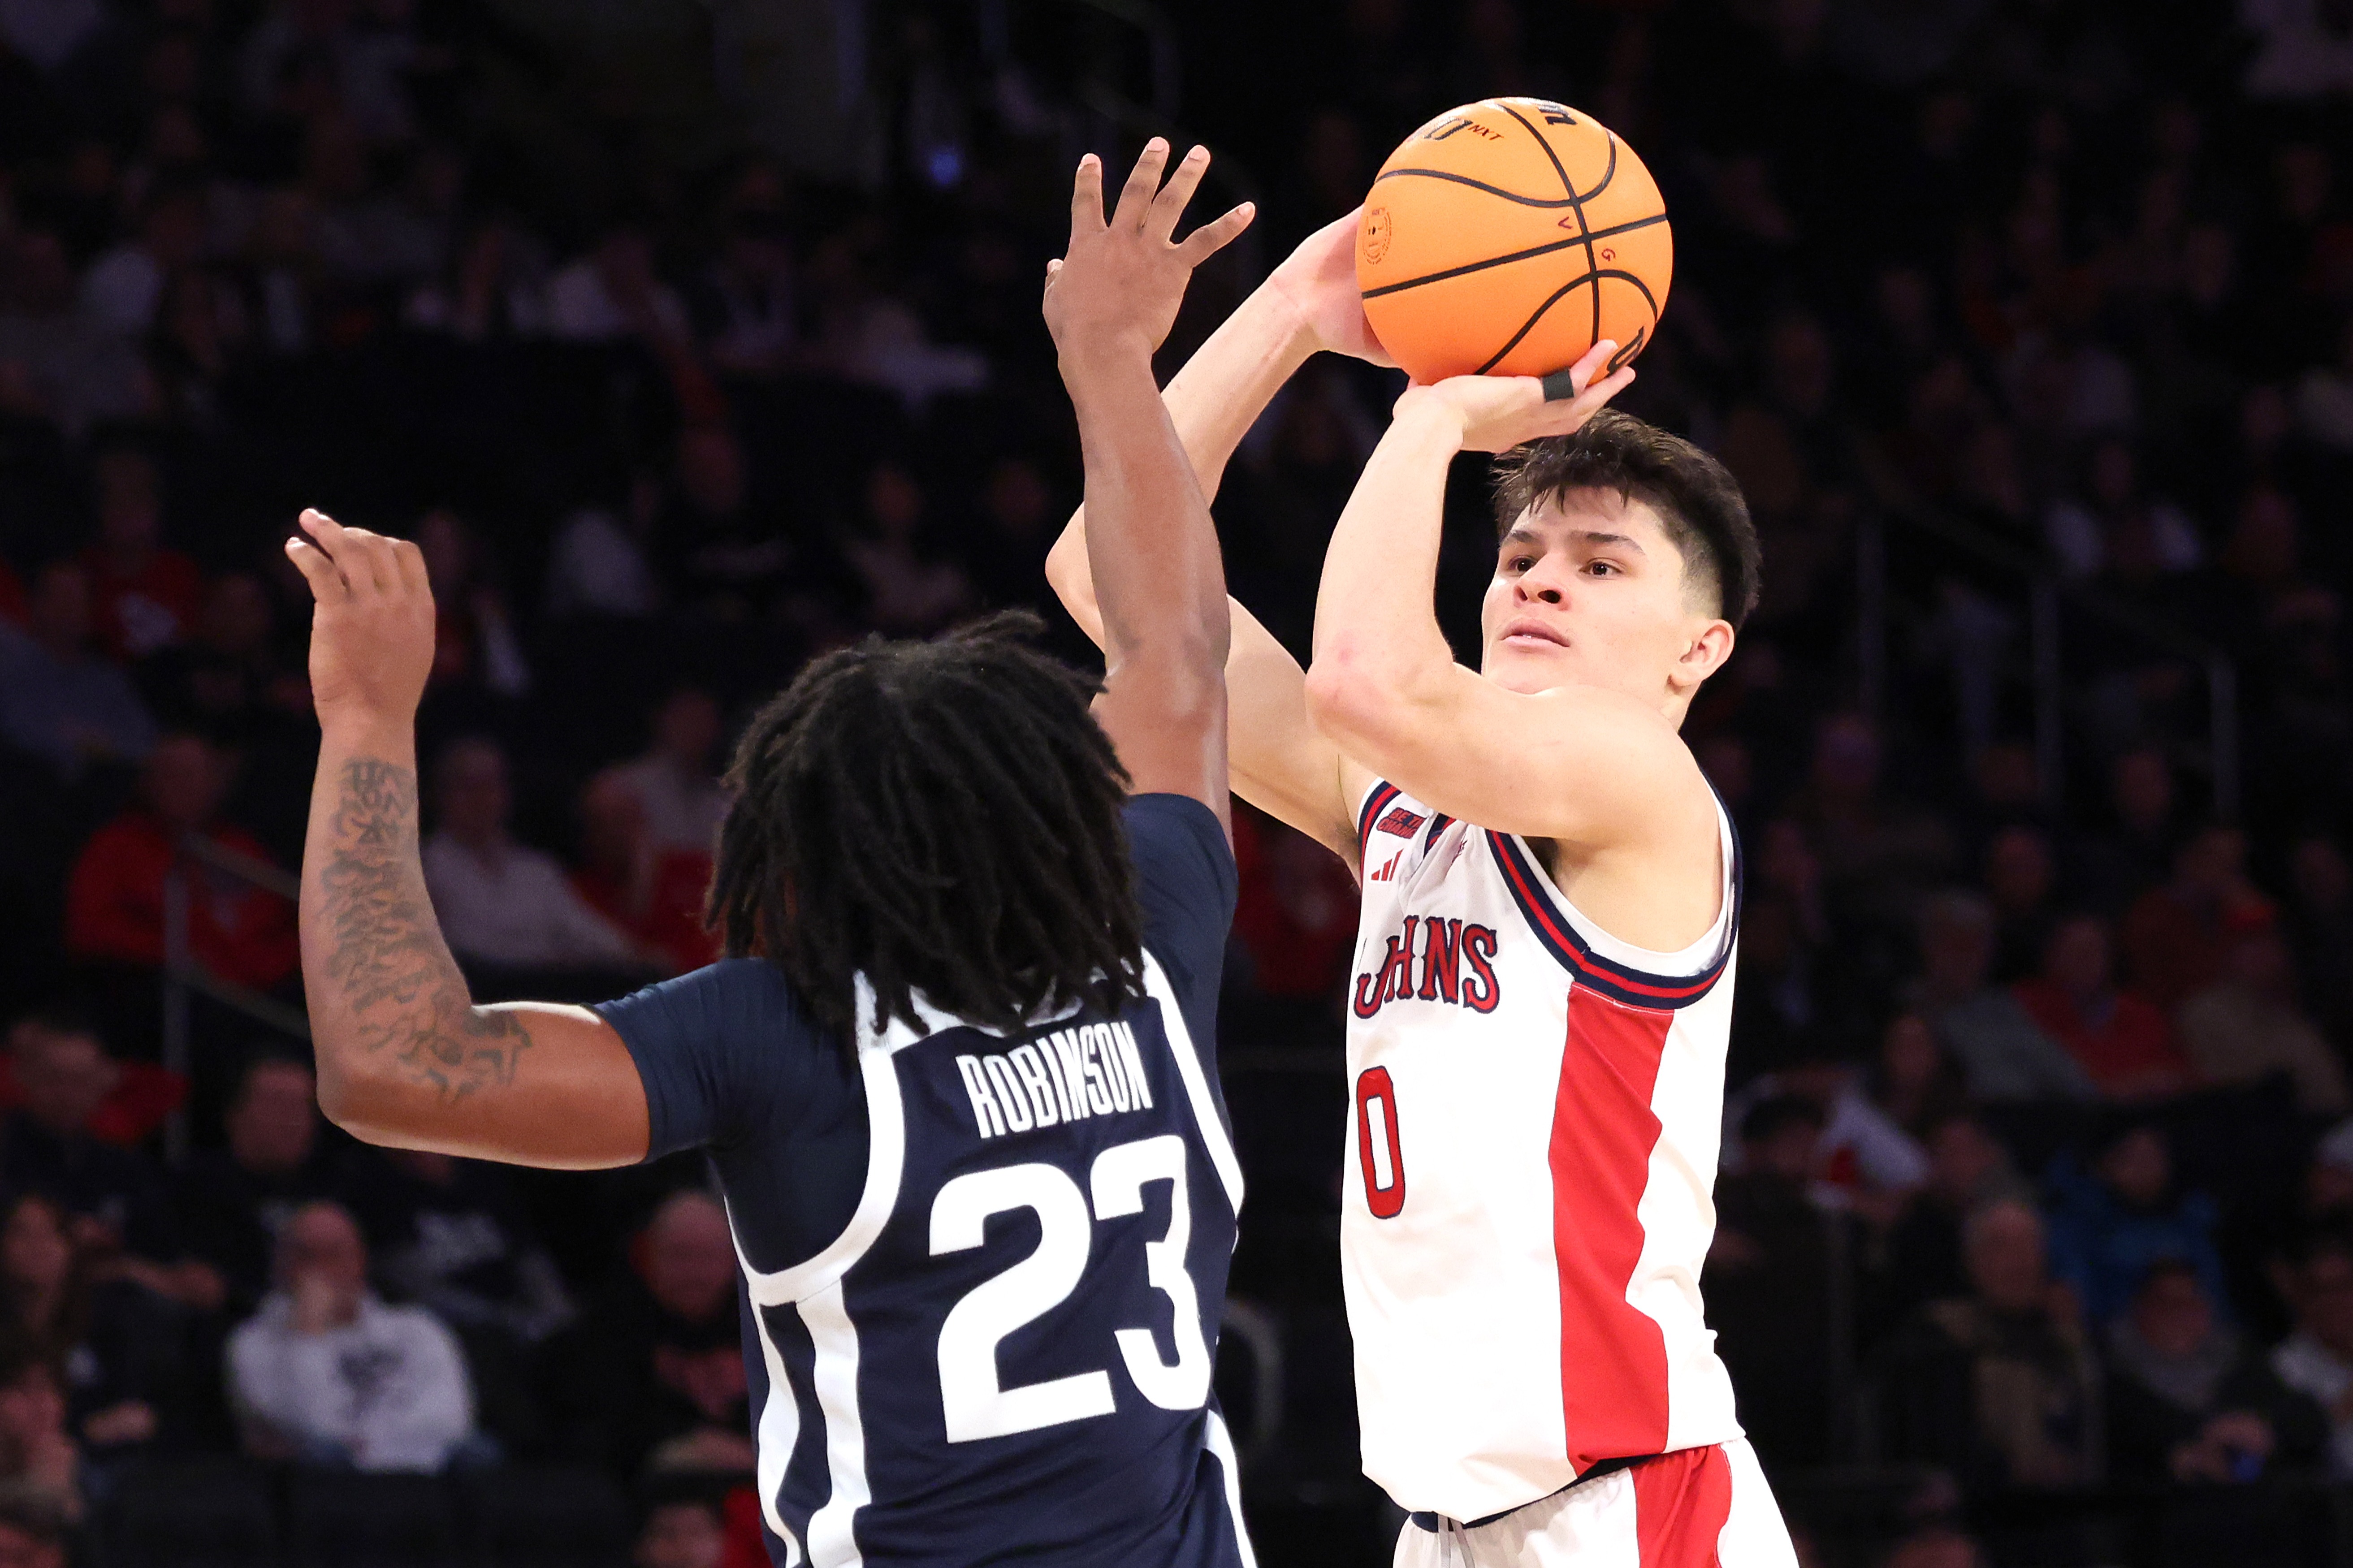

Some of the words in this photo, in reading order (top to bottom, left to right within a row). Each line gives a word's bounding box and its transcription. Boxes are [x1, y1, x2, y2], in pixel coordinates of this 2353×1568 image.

[1468, 124, 1504, 141] NXT
[1354, 915, 1500, 1019] JHNS
[956, 1020, 1153, 1139] ROBINSON
[1356, 1065, 1406, 1220] 0
[929, 1135, 1211, 1444] 23
